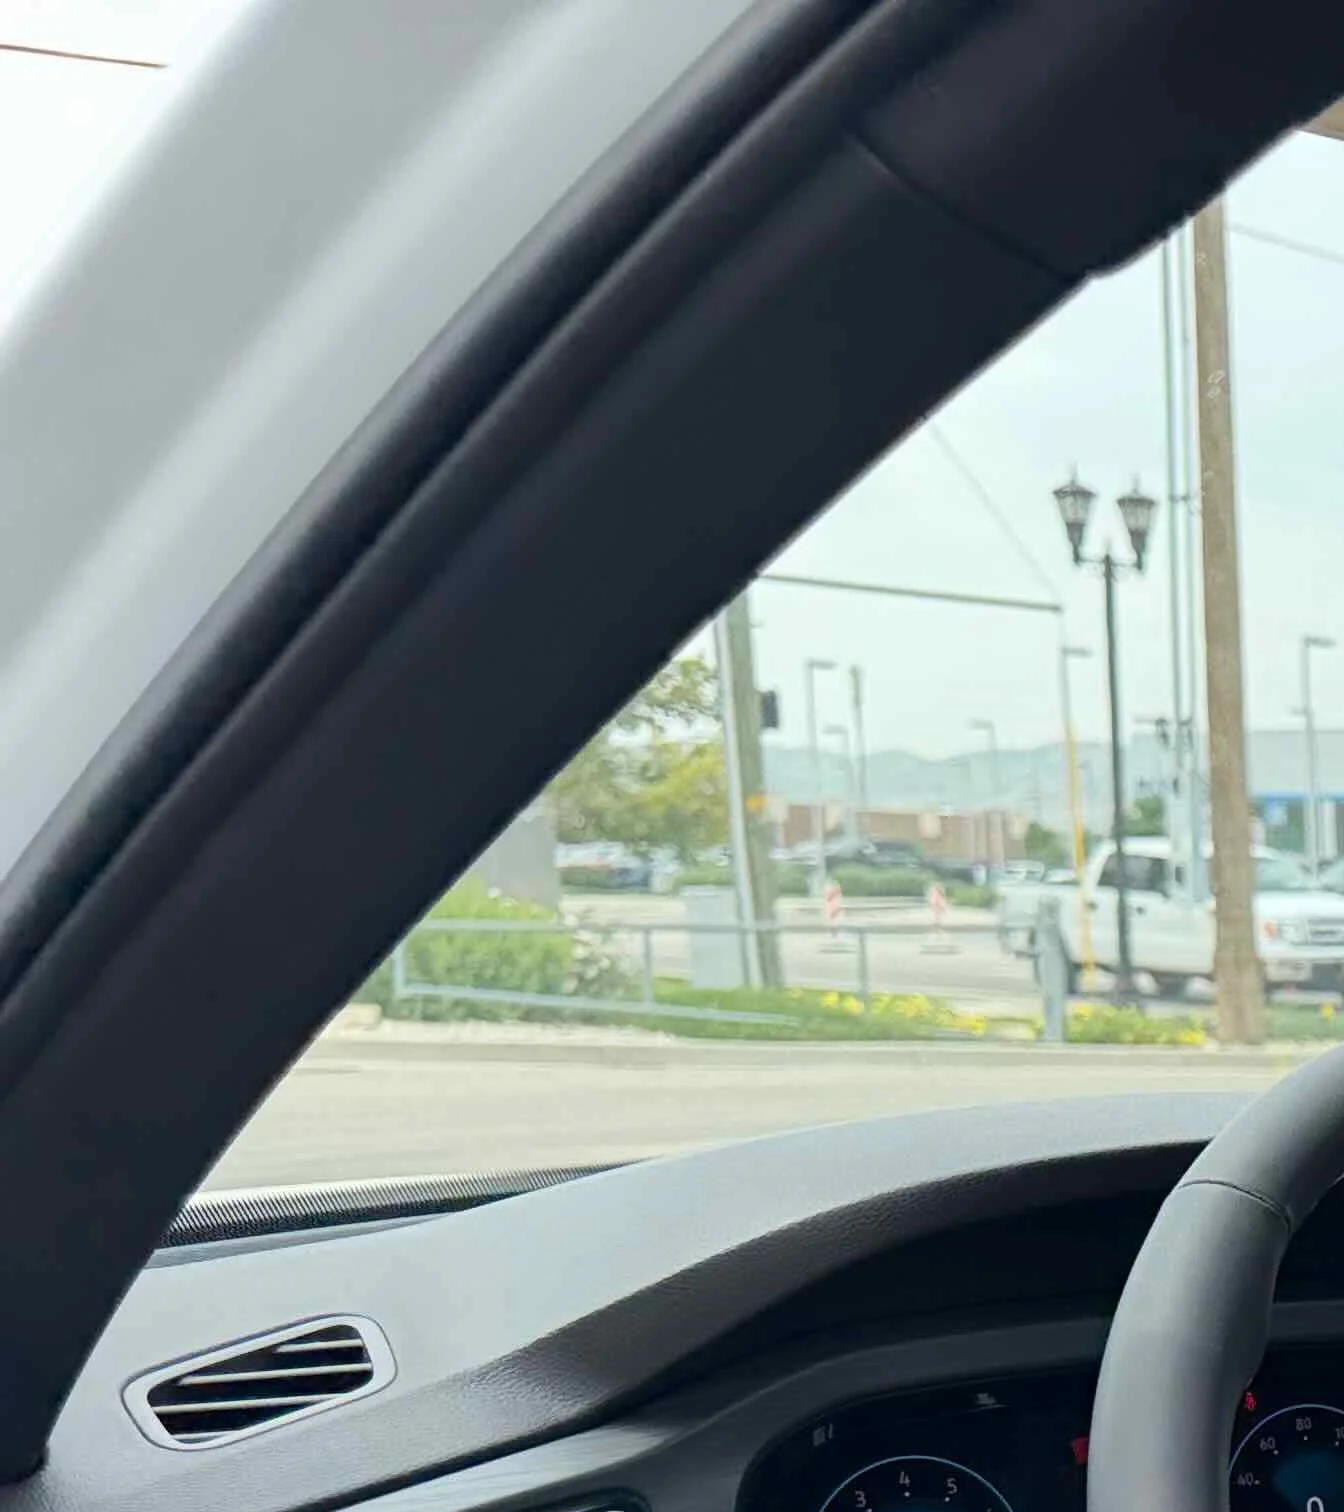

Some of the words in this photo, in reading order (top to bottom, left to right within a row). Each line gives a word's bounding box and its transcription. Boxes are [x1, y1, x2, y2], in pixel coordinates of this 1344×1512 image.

[1296, 1417, 1312, 1431] 80
[1259, 1436, 1276, 1450] 60
[899, 1471, 911, 1485] 4
[1237, 1473, 1254, 1486] 40
[946, 1479, 958, 1494] 5
[855, 1491, 867, 1508] 3
